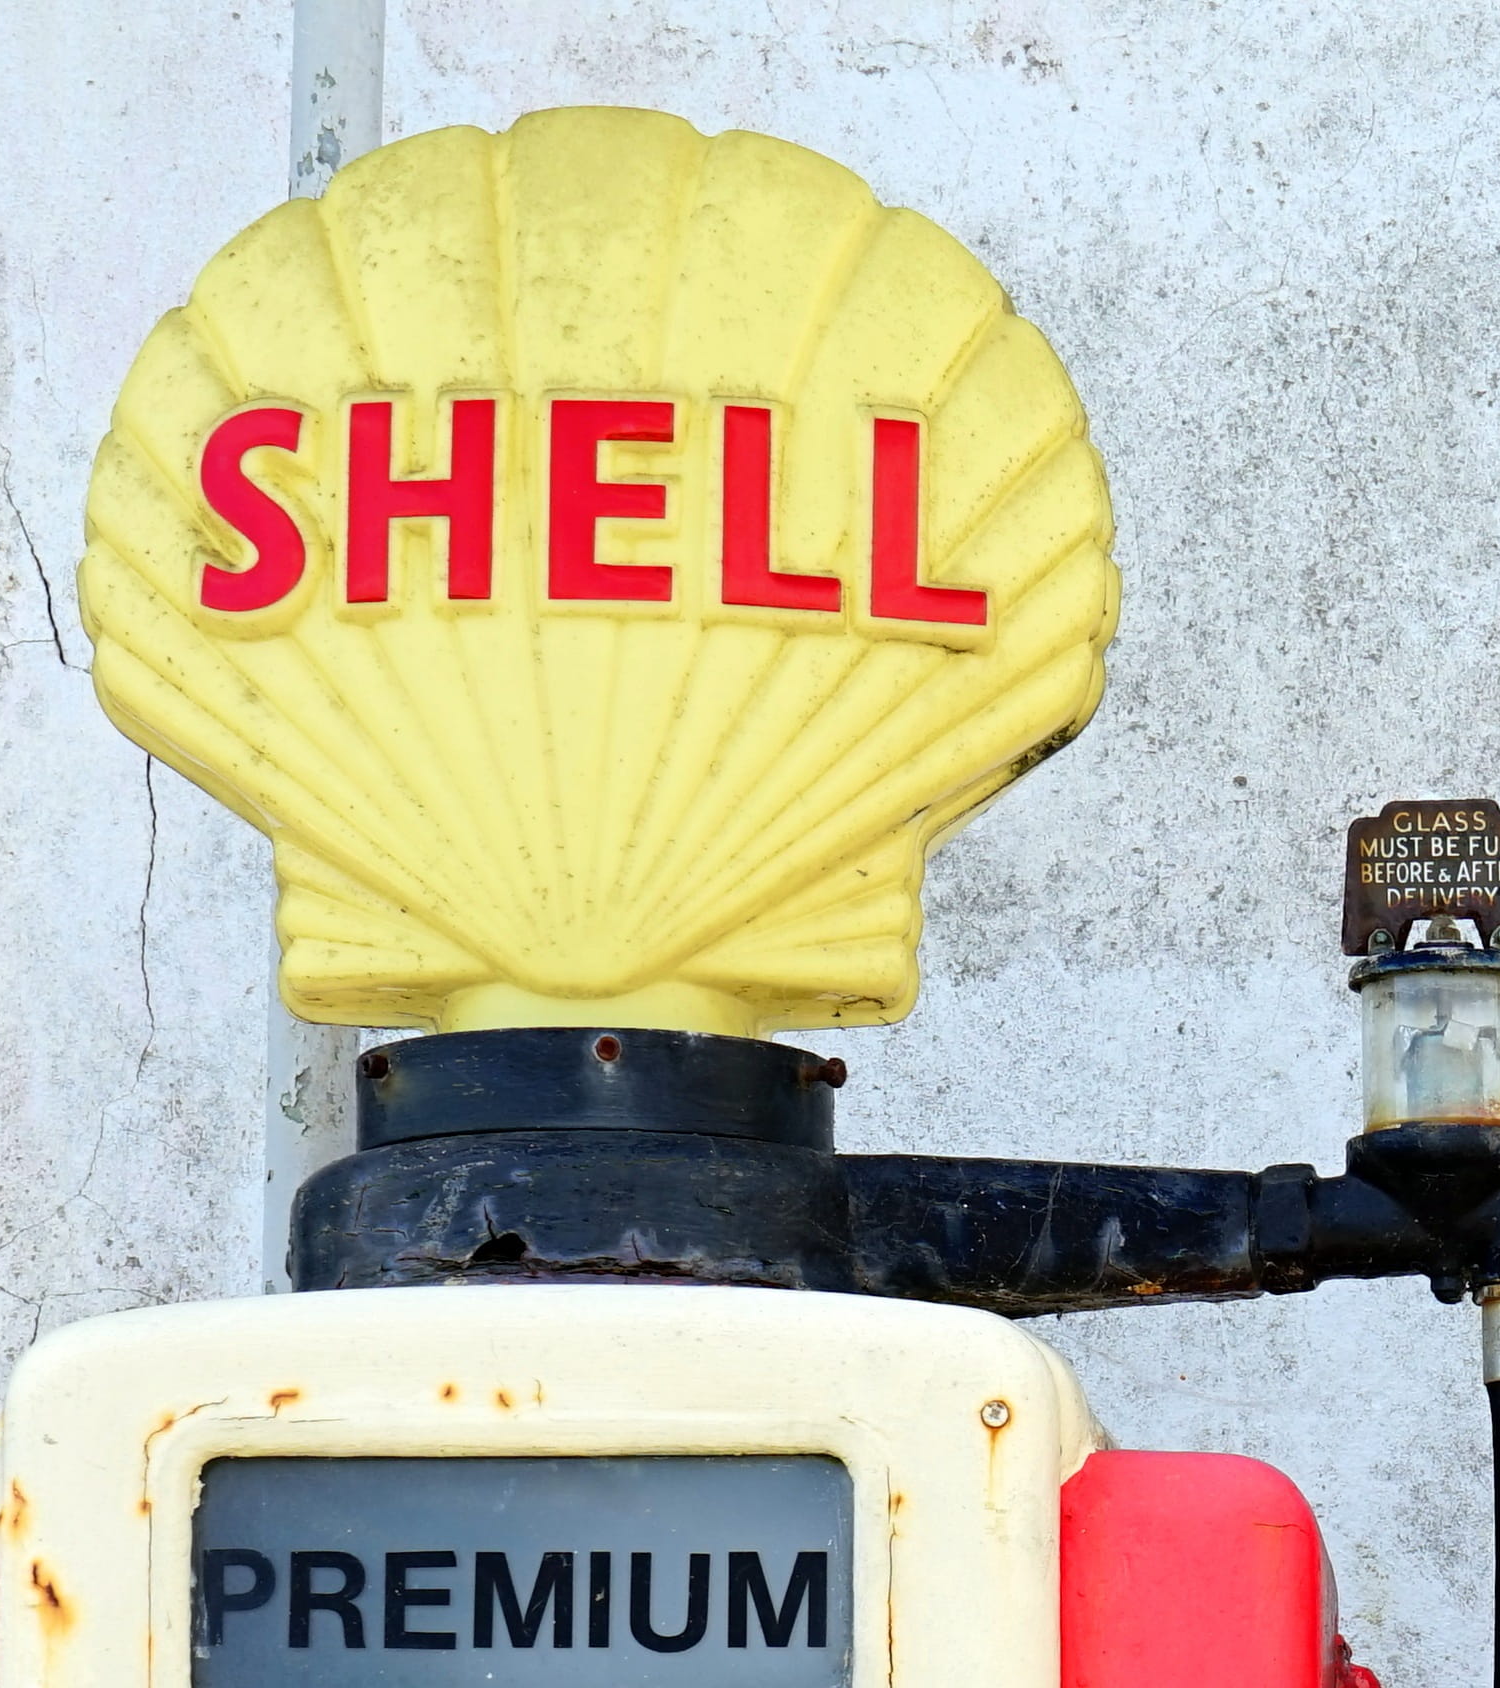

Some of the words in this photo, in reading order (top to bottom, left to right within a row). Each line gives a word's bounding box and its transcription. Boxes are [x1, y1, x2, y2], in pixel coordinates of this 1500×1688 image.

[198, 398, 987, 627] SHELL
[1392, 810, 1488, 833] GLASS
[1360, 836, 1423, 859] MUST
[1431, 836, 1460, 858] BE
[1360, 861, 1435, 884] BEFORE
[1438, 868, 1452, 882] &
[1387, 887, 1499, 909] DELIVERY
[202, 1548, 828, 1653] PREMIUM
